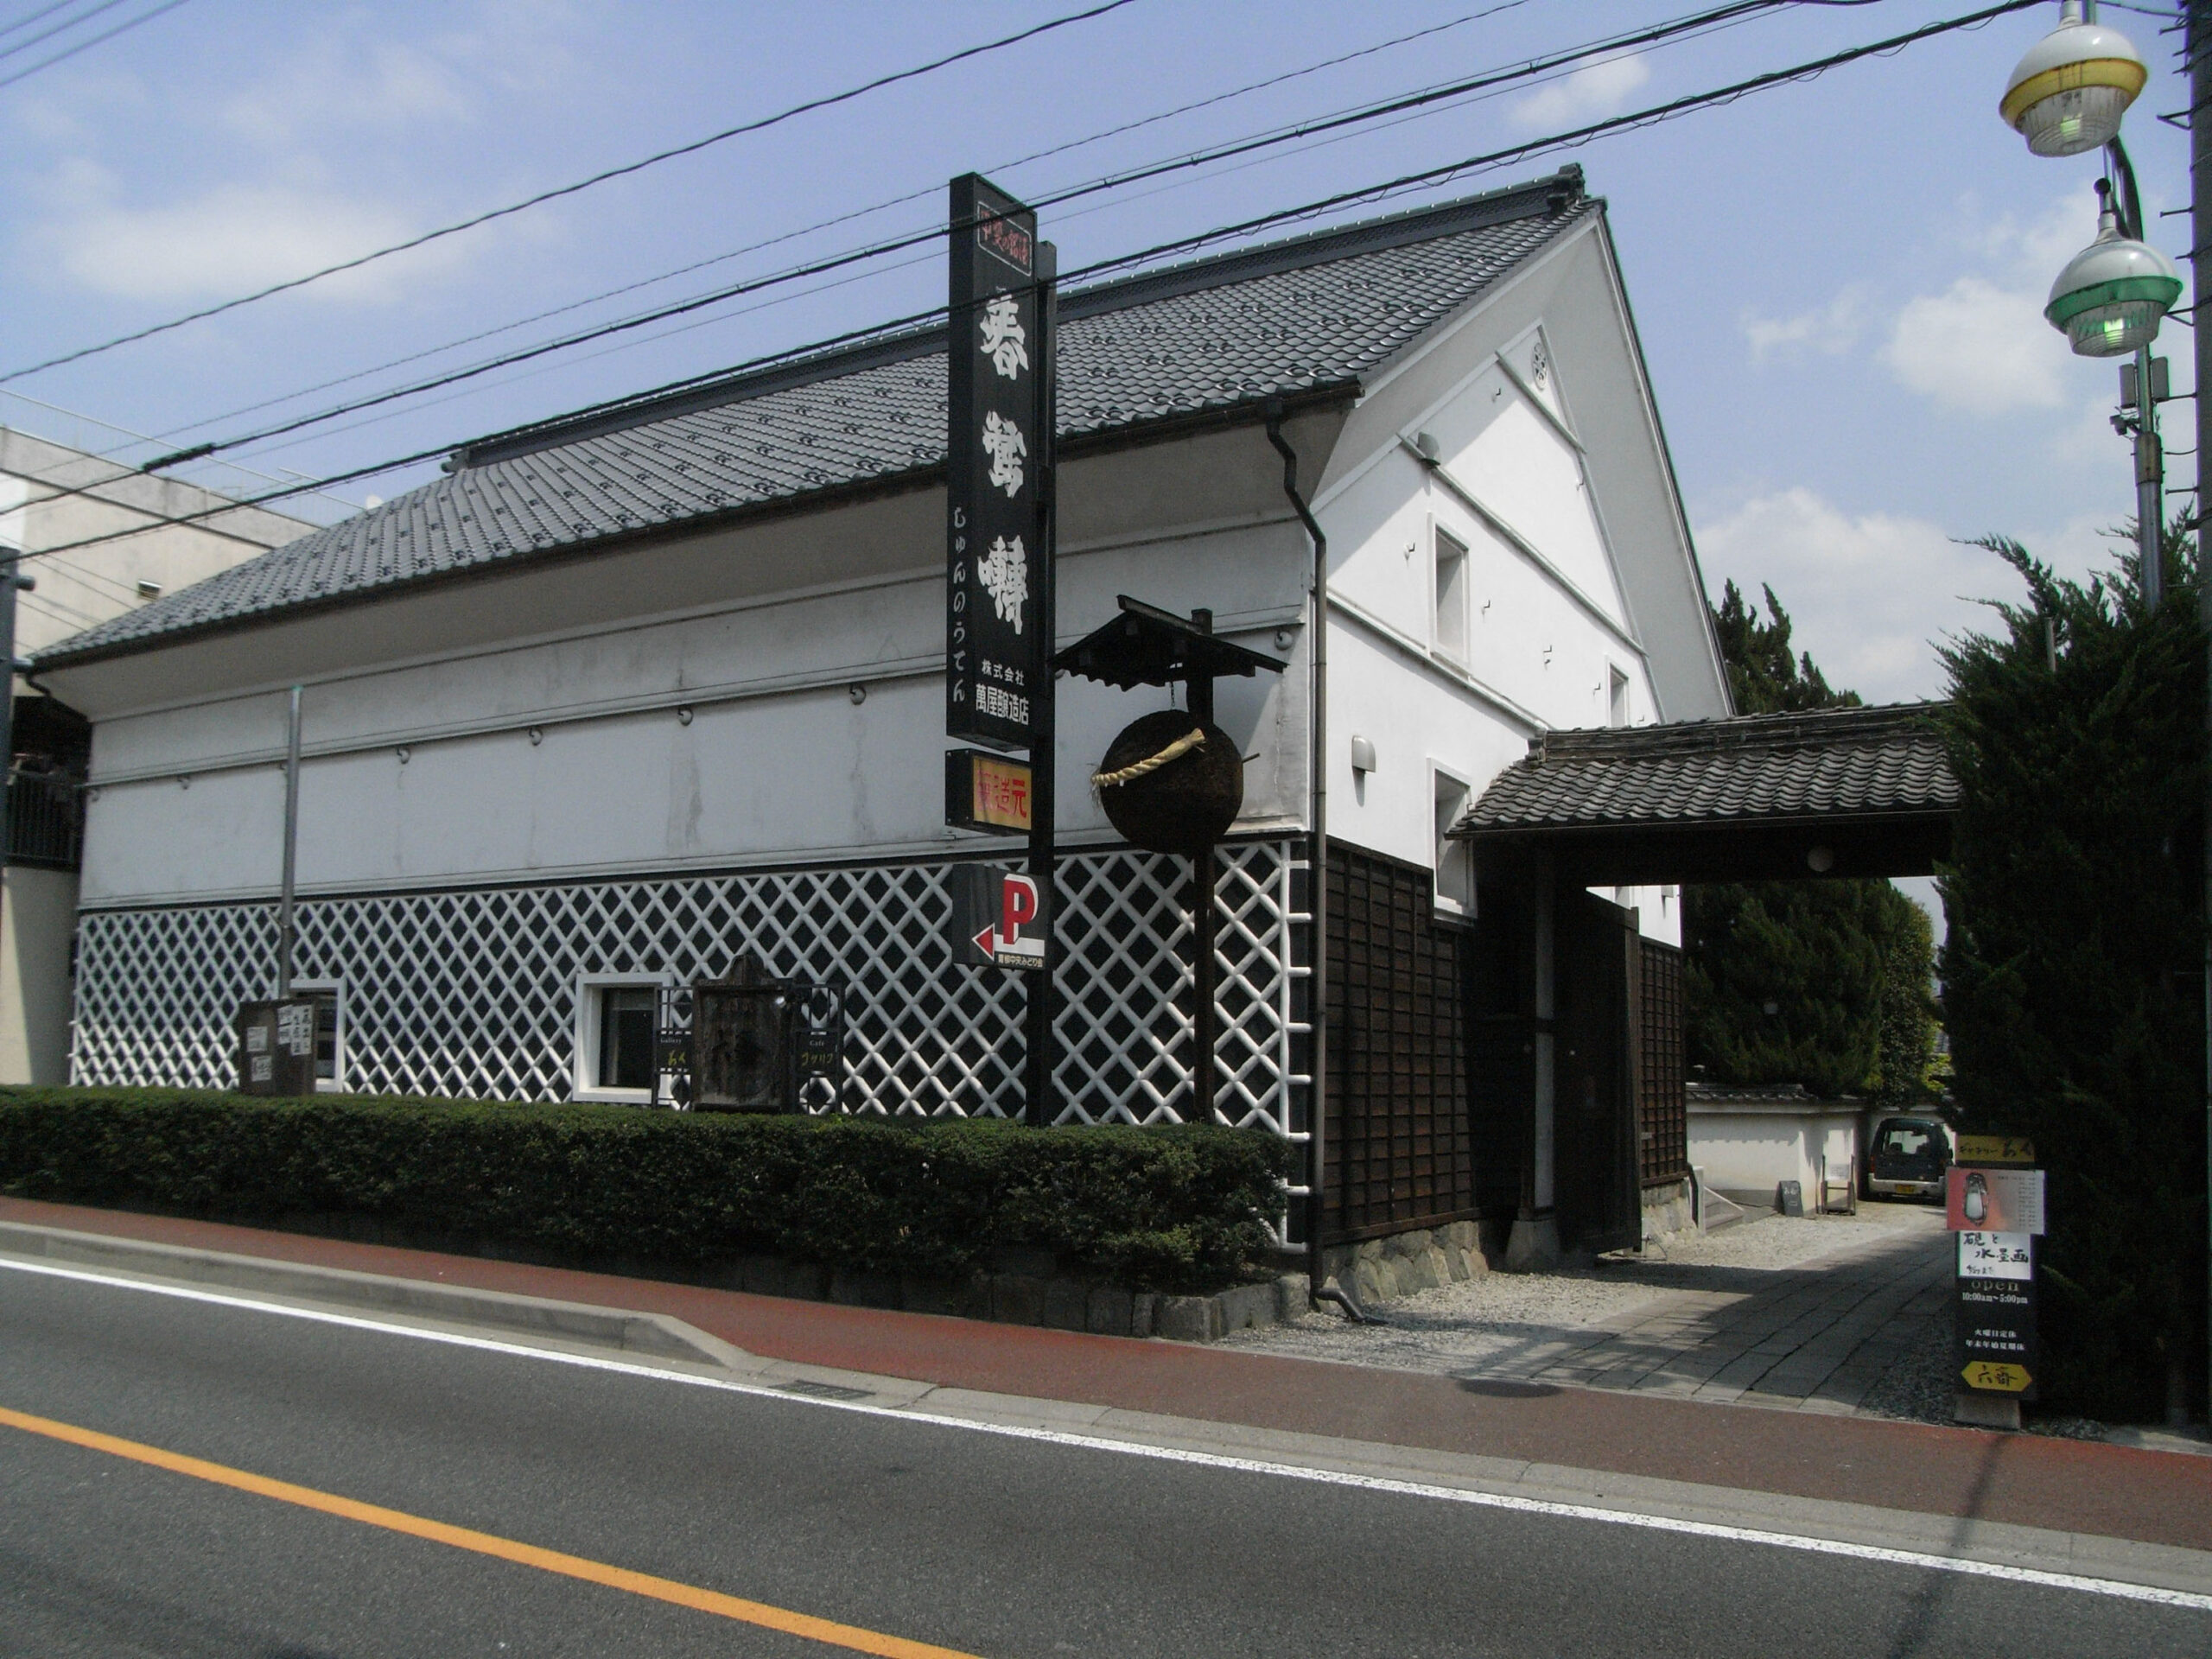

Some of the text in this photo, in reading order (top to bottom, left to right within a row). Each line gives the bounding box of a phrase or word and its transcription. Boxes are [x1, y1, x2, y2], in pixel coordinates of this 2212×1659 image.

[952, 506, 967, 703] しゅんのうてん
[981, 658, 1025, 687] 株式会社
[1003, 873, 1039, 946] P
[1974, 1248, 2029, 1263] 水墨画
